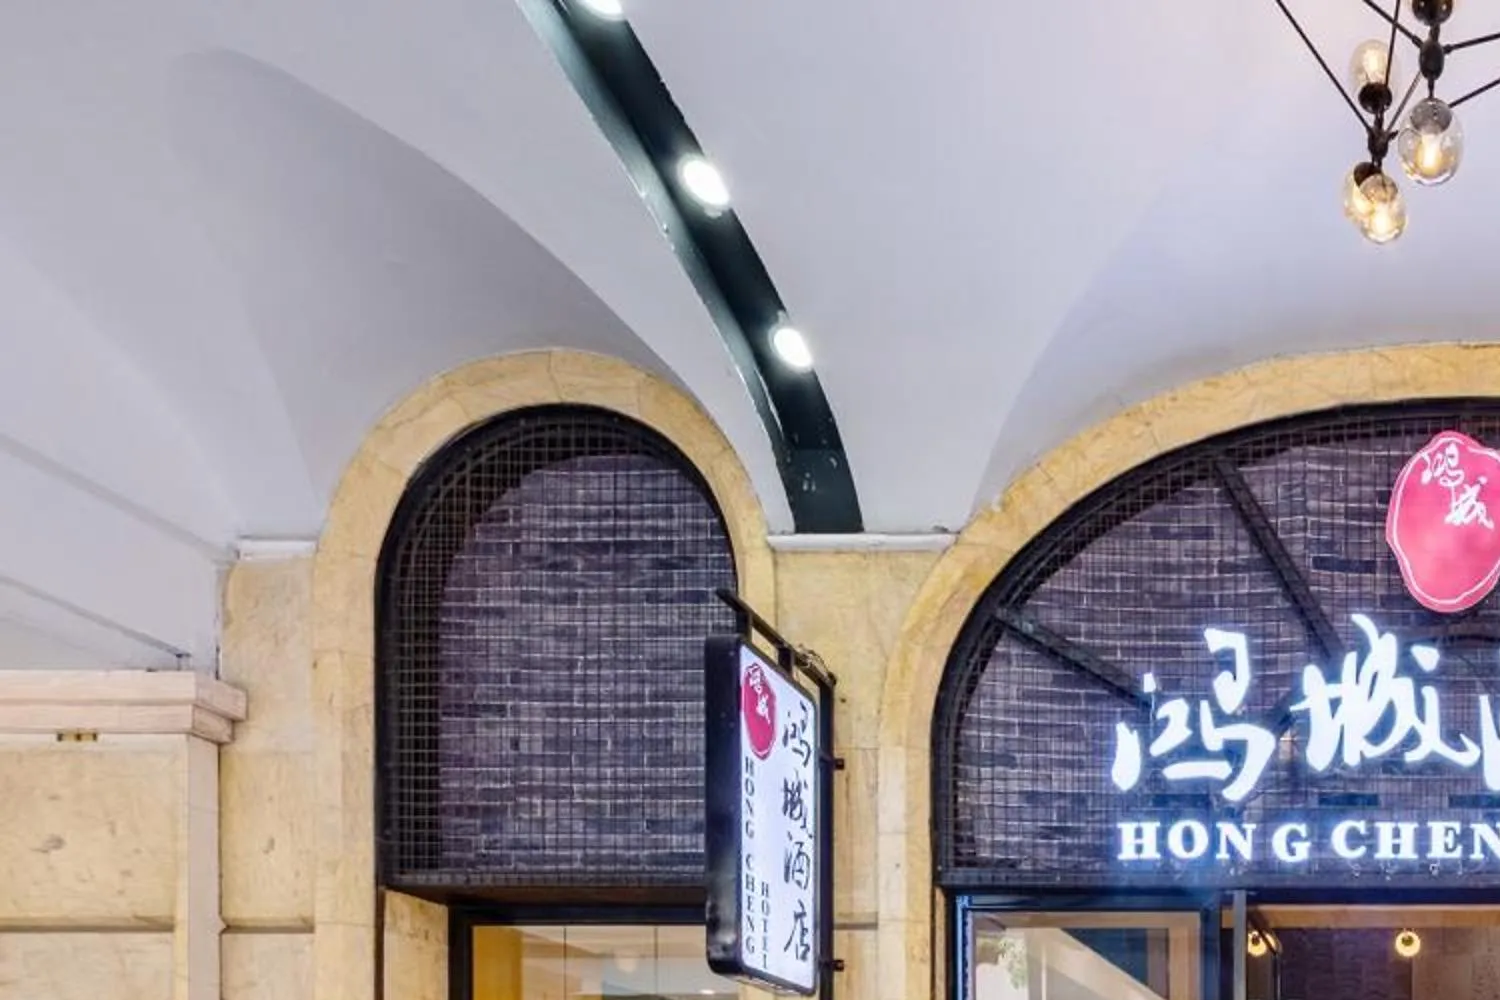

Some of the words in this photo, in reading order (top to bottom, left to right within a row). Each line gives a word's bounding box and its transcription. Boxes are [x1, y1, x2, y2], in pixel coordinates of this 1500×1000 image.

[745, 756, 755, 839] HONG
[782, 701, 814, 962] 鸿城酒店
[1118, 820, 1310, 863] HONG
[745, 853, 755, 954] CHENG
